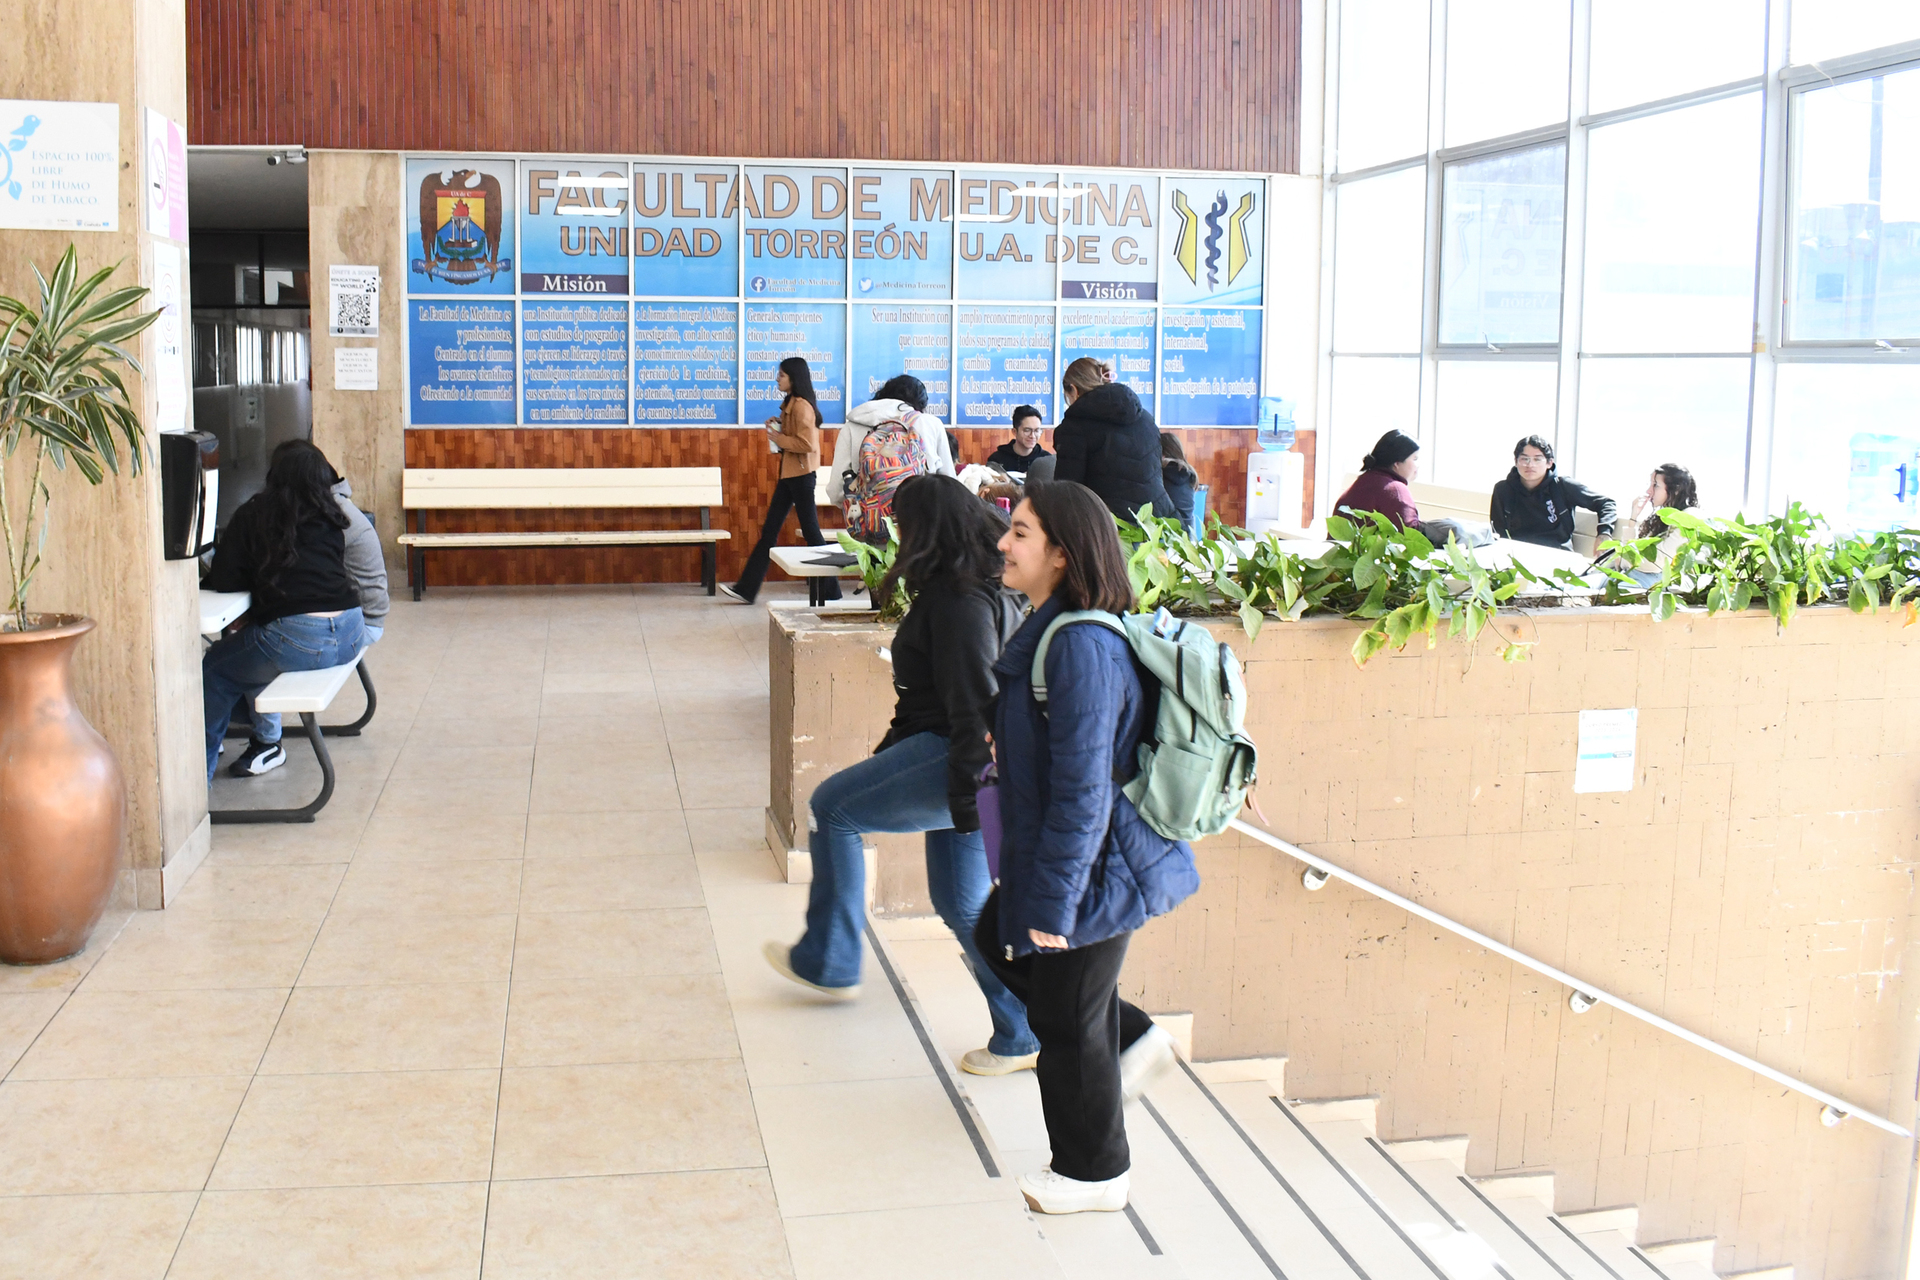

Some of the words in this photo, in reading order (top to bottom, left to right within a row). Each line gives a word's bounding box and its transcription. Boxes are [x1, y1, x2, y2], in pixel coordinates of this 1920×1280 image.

[32, 150, 80, 161] ESPACIO
[85, 152, 114, 162] 100%
[32, 166, 63, 175] LIBRE
[32, 181, 47, 189] DE
[51, 180, 91, 191] HUMO
[32, 195, 47, 204] DE
[528, 169, 800, 219] FACULTAD
[812, 176, 881, 220] DE
[910, 177, 1152, 227] MEDICINA
[560, 226, 722, 257] UNIDAD
[746, 223, 927, 260] TORREÓN
[960, 232, 1032, 262] U.A.
[1045, 235, 1100, 264] DE
[1112, 236, 1147, 265] C.
[542, 274, 608, 292] Misión
[767, 278, 797, 286] Facultad
[799, 278, 807, 286] de
[808, 279, 841, 287] Medicina
[1081, 282, 1138, 299] Visión
[419, 306, 429, 321] La
[429, 306, 459, 321] Facultad
[460, 306, 469, 321] de
[470, 306, 503, 321] Medicina
[504, 310, 512, 321] es
[523, 310, 536, 321] una
[537, 306, 573, 321] Institución
[574, 306, 598, 325] pública
[599, 306, 627, 322] dedicada
[648, 306, 678, 321] formación
[679, 307, 703, 325] integral
[704, 307, 711, 321] de
[711, 307, 737, 322] Médicos
[746, 308, 780, 323] Generales
[781, 312, 823, 326] competentes
[872, 308, 885, 323] Ser
[885, 312, 898, 323] una
[899, 308, 936, 323] Institución
[937, 313, 949, 323] con
[960, 309, 983, 328] amplio
[984, 309, 1033, 325] reconocimiento
[1034, 313, 1045, 328] por
[1046, 314, 1054, 325] su
[1063, 311, 1093, 325] excelente
[1094, 311, 1110, 325] nivel
[1111, 311, 1145, 326] académico
[1146, 312, 1154, 326] de
[1163, 310, 1206, 331] investigación
[463, 326, 513, 344] profesionistas,
[525, 330, 539, 341] con
[541, 326, 572, 341] estudios
[573, 326, 583, 341] de
[584, 326, 619, 345] posgrado
[635, 326, 681, 345] investigación,
[683, 330, 696, 341] con
[697, 326, 711, 341] alto
[711, 327, 736, 341] sentido
[770, 328, 807, 342] humanista.
[899, 334, 911, 350] que
[912, 333, 935, 346] cuente
[936, 335, 949, 347] con
[960, 331, 976, 347] todos
[976, 336, 986, 347] sus
[987, 335, 1019, 352] programas
[1020, 332, 1028, 348] de
[1028, 332, 1052, 351] calidad,
[1065, 336, 1077, 348] con
[1078, 333, 1115, 349] vinculación
[1116, 332, 1144, 349] nacional
[1163, 332, 1208, 353] internacional,
[435, 346, 467, 361] Centrado
[468, 350, 478, 361] en
[486, 346, 513, 361] alumno
[524, 349, 537, 364] que
[537, 346, 561, 364] ejercen
[570, 345, 601, 364] liderazgo
[606, 346, 627, 361] través
[635, 345, 643, 361] de
[644, 346, 691, 361] conocimientos
[692, 346, 714, 361] sólidos
[721, 346, 729, 361] de
[747, 350, 779, 362] constante
[823, 352, 833, 362] en
[904, 355, 949, 373] promoviendo
[963, 353, 991, 371] cambios
[1004, 354, 1048, 371] encaminados
[1120, 354, 1150, 371] bienestar
[438, 365, 449, 381] los
[450, 369, 477, 381] avances
[530, 365, 570, 384] tecnológicos
[570, 365, 611, 381] relacionados
[612, 369, 621, 380] en
[639, 365, 669, 384] ejercicio
[670, 365, 679, 380] de
[683, 365, 692, 380] la
[695, 365, 731, 383] medicina,
[746, 366, 775, 381] nacional
[421, 385, 460, 401] Ofreciendo
[474, 385, 513, 401] comunidad
[526, 389, 537, 400] sus
[538, 385, 567, 400] servicios
[588, 387, 602, 400] tres
[602, 385, 626, 400] niveles
[635, 385, 644, 400] de
[675, 385, 701, 400] creando
[702, 385, 737, 400] conciencia
[746, 385, 764, 401] sobre
[935, 381, 948, 393] una
[961, 376, 970, 393] de
[970, 376, 980, 393] las
[981, 377, 1007, 398] mejores
[1007, 376, 1042, 394] Facultades
[1043, 376, 1052, 394] de
[1145, 382, 1154, 394] en
[1170, 377, 1211, 399] investigación
[530, 409, 540, 420] en
[551, 404, 583, 420] ambiente
[584, 404, 593, 420] de
[593, 404, 627, 420] rendición
[637, 404, 646, 419] de
[647, 406, 672, 419] cuentas
[686, 404, 717, 419] sociedad.
[965, 400, 1001, 420] estrategias
[1001, 399, 1010, 416] de
